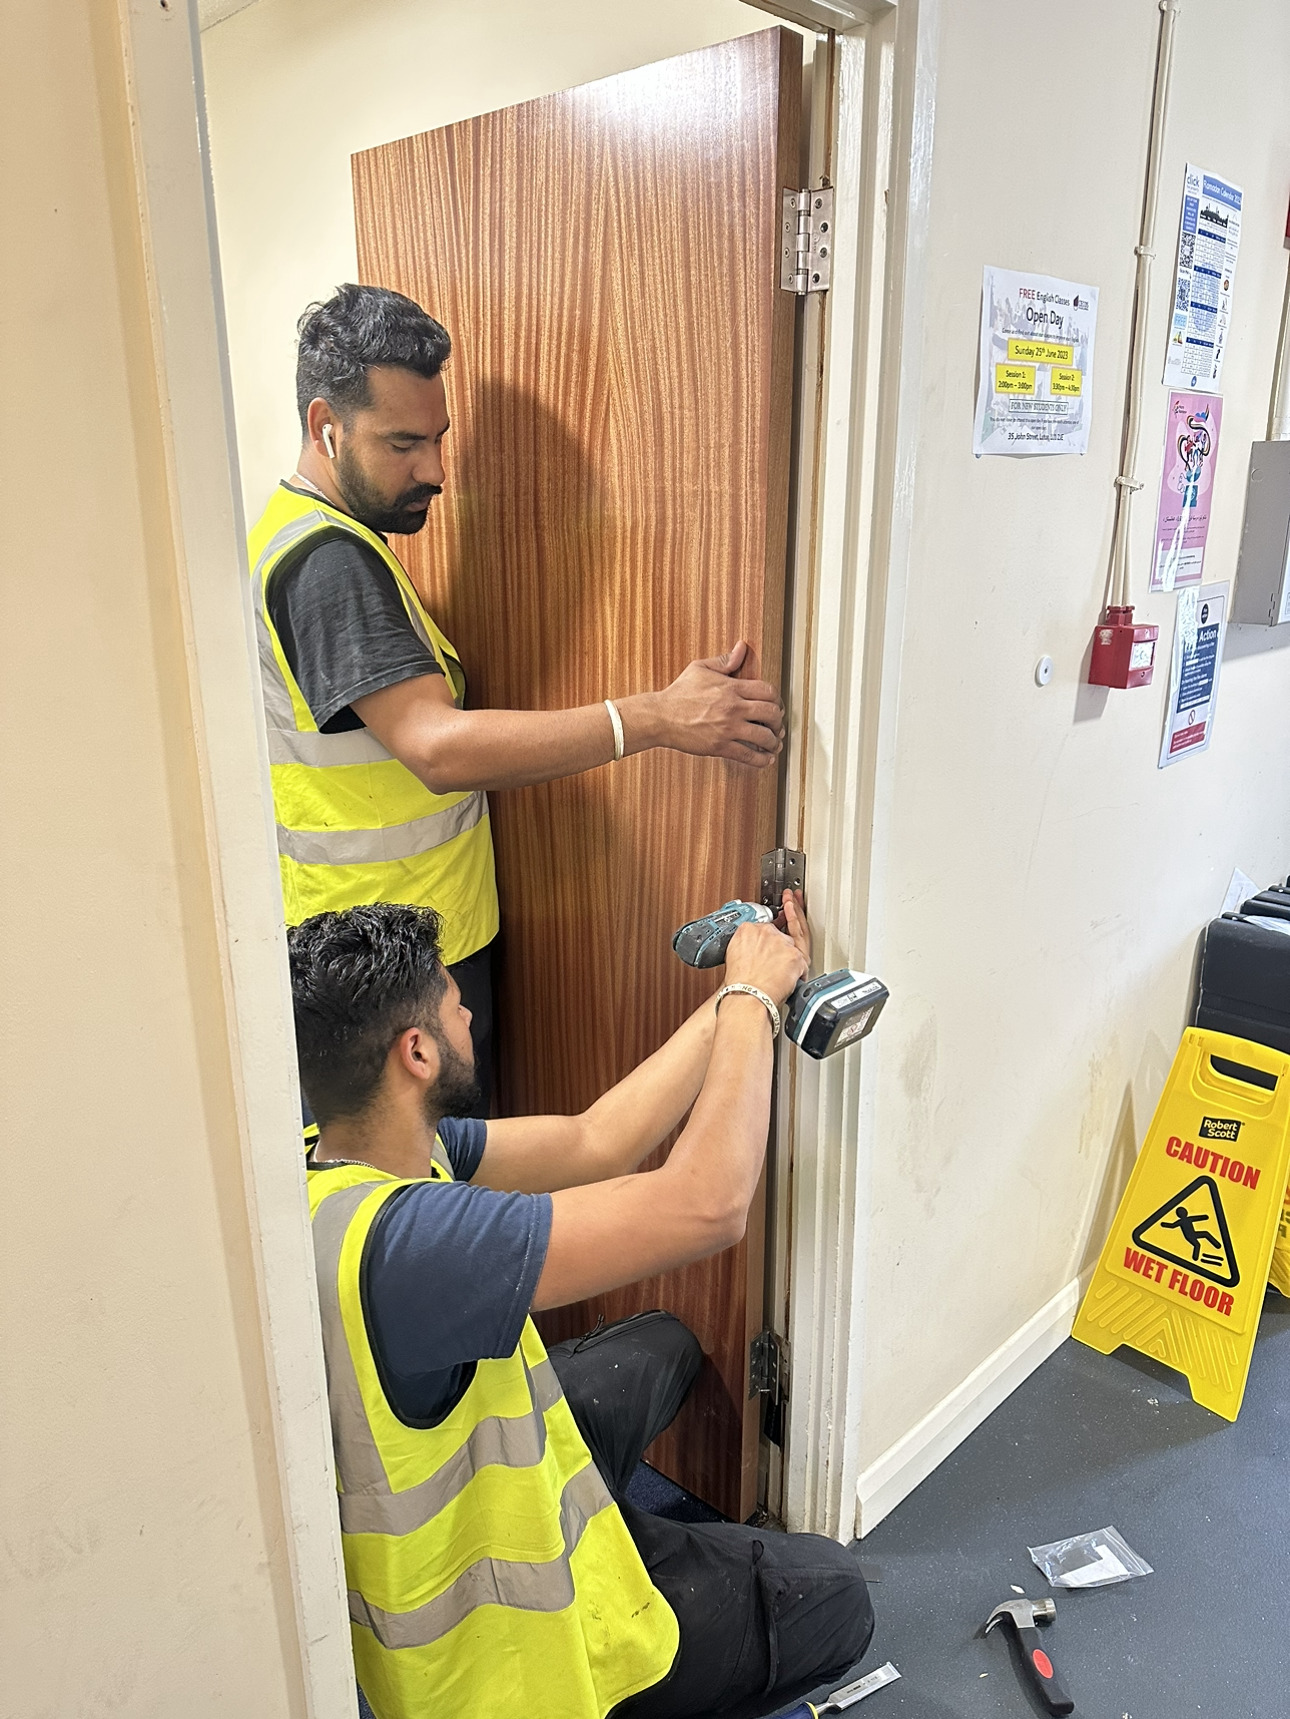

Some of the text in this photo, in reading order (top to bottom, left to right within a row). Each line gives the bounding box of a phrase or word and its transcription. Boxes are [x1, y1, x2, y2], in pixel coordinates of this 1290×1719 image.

[1187, 174, 1199, 187] click
[1019, 288, 1035, 300] FREE
[1037, 291, 1054, 304] English
[1055, 294, 1070, 306] Classes
[1026, 307, 1064, 329] Open Day
[1015, 345, 1068, 360] Sunday 25th June 2023
[1006, 370, 1021, 378] Session
[998, 381, 1013, 389] 2:00pm
[1010, 402, 1021, 410] FOR
[1022, 402, 1033, 410] NEW
[1034, 402, 1054, 411] STUDENTS
[1199, 629, 1217, 642] Action
[1203, 1119, 1238, 1131] Robert
[1207, 1128, 1236, 1139] Scott
[1165, 1136, 1261, 1190] CAUTION
[1123, 1246, 1235, 1317] WET FLOOR
